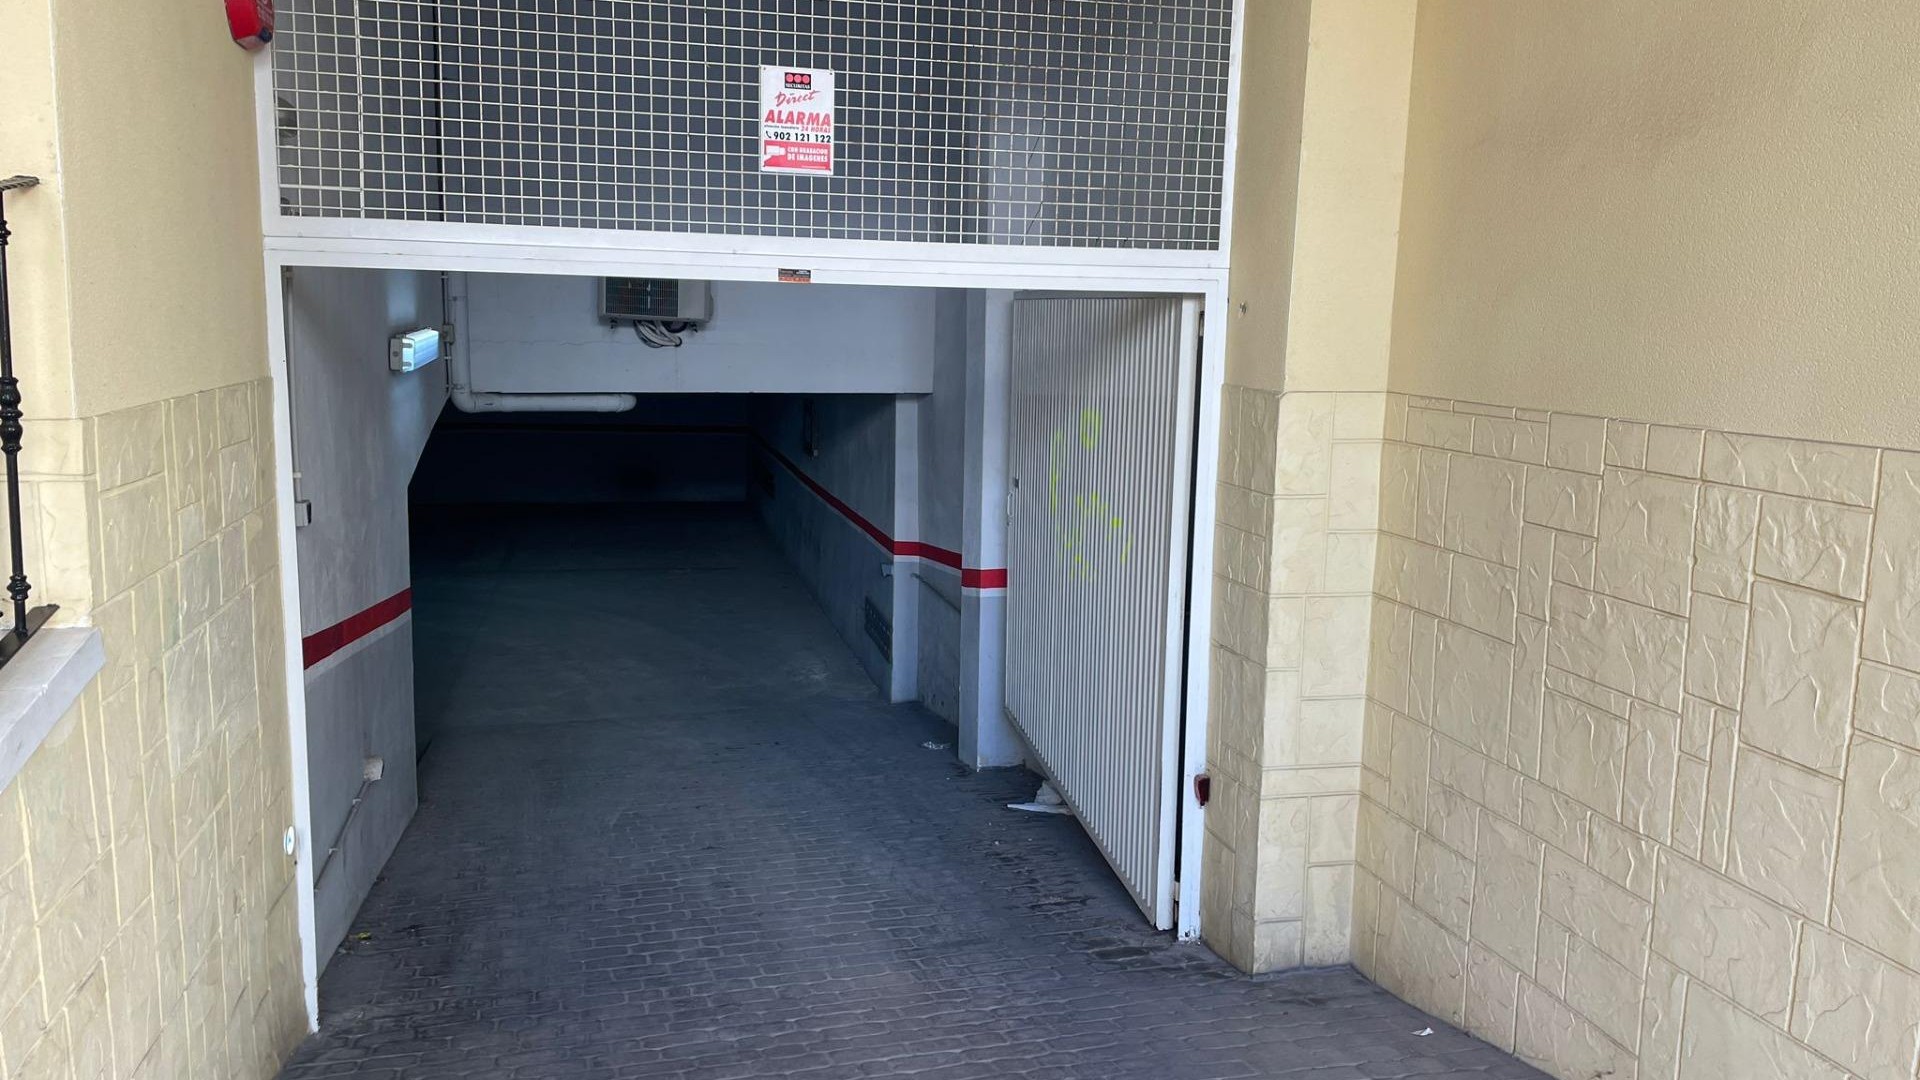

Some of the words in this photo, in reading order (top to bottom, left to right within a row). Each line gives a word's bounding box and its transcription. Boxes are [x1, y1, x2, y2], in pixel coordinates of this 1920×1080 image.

[775, 90, 820, 107] Direct
[764, 109, 831, 127] ALARMA
[773, 131, 791, 140] 902
[795, 133, 810, 142] 121
[815, 134, 831, 143] 122
